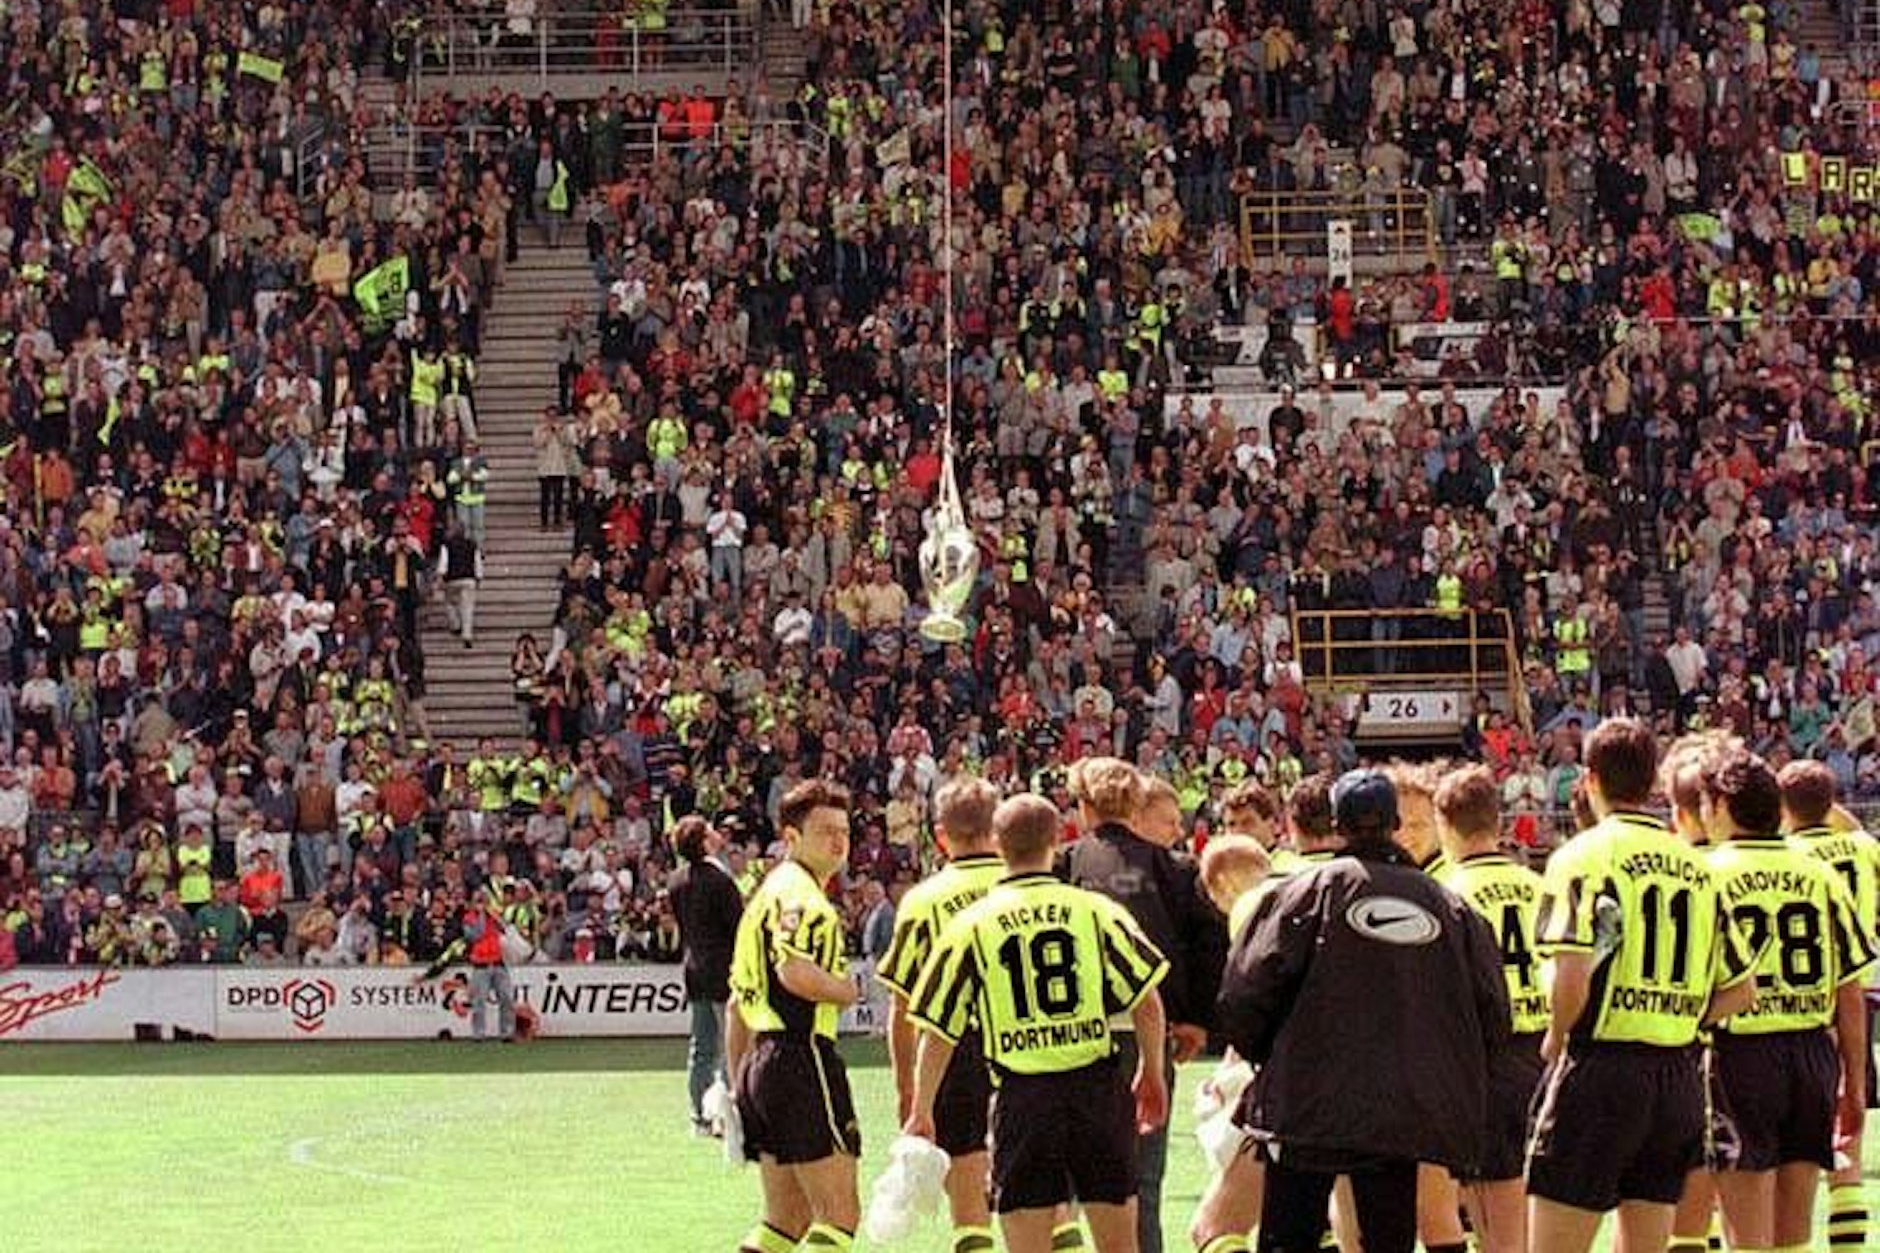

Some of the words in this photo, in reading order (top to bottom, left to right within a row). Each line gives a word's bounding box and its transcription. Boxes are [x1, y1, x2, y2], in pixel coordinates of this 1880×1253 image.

[1390, 698, 1418, 718] 26
[1833, 859, 1859, 900] 7
[998, 904, 1072, 932] RICKEN
[1642, 883, 1692, 986] 11
[1502, 904, 1535, 988] 4
[1733, 902, 1824, 988] 28
[999, 927, 1082, 1021] 18
[231, 987, 280, 1006] DPD
[351, 986, 447, 1005] SYSTEM
[1000, 1018, 1106, 1053] DORTMUND
